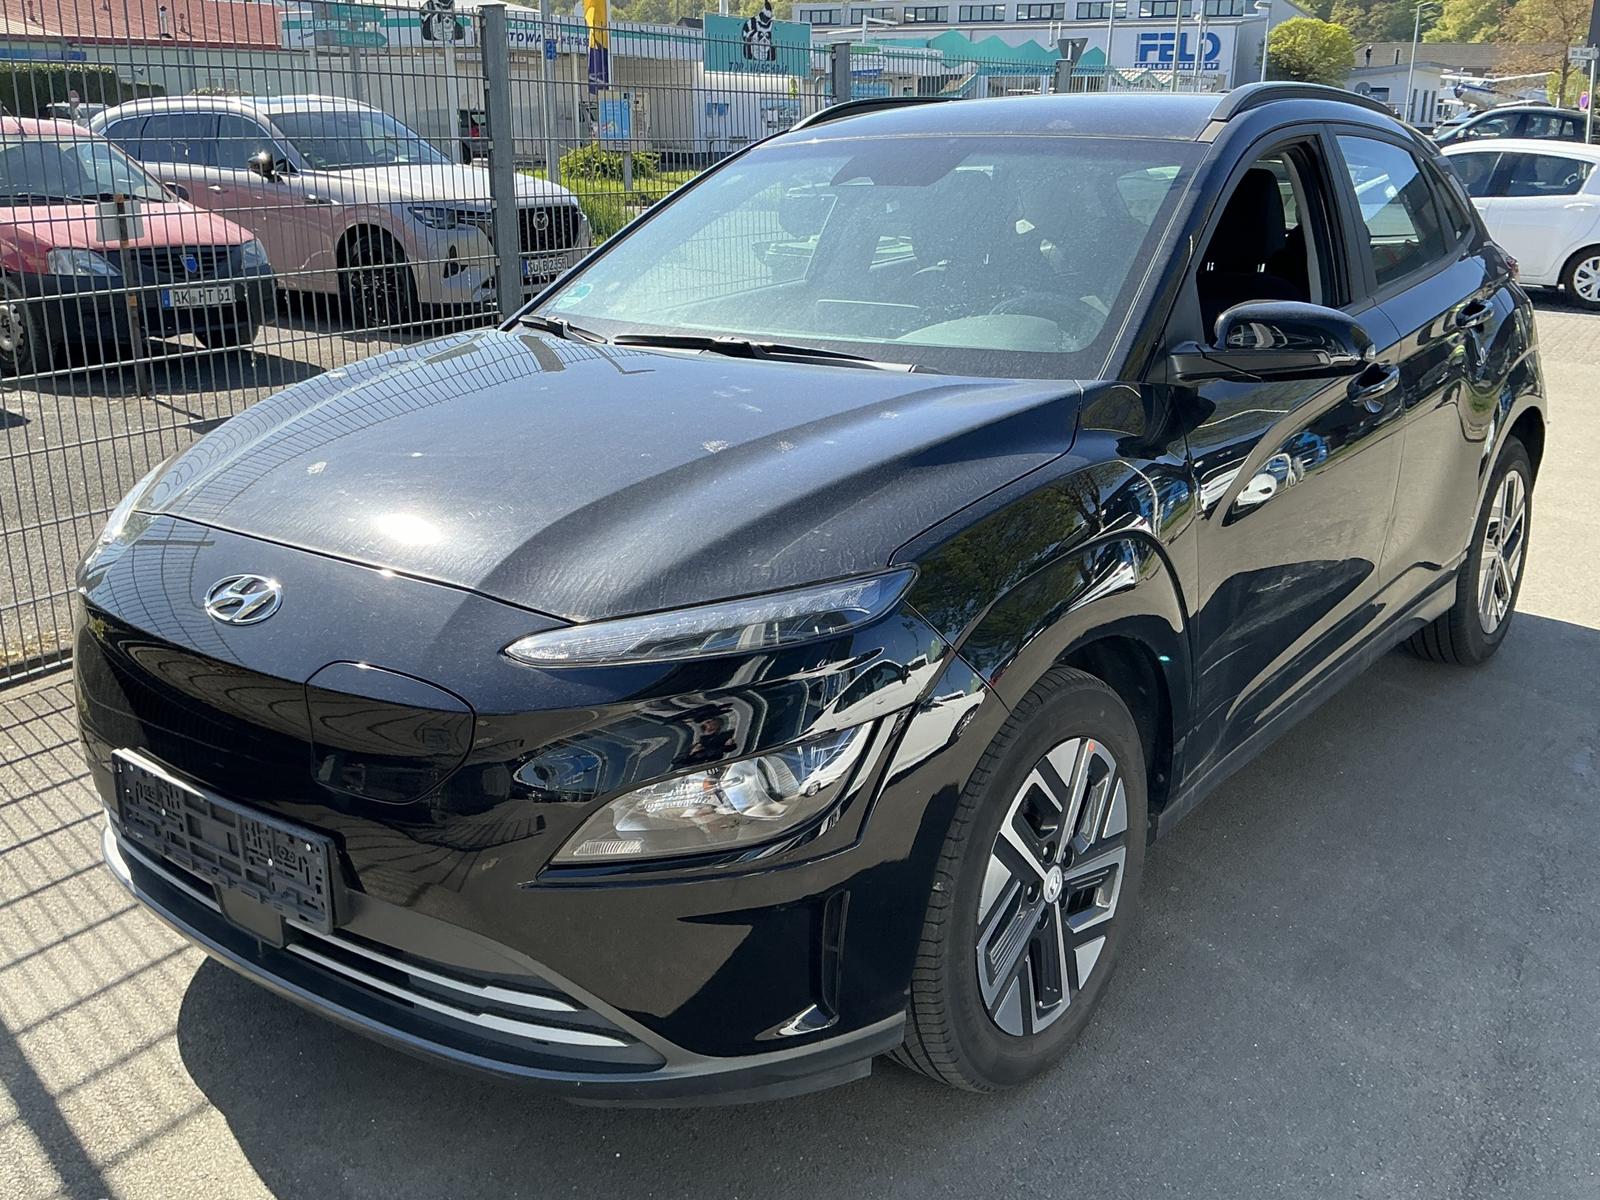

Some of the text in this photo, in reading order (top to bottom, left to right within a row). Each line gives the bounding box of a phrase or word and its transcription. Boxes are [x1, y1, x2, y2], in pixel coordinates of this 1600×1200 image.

[1139, 32, 1221, 62] FELD
[542, 260, 548, 271] B
[174, 290, 190, 305] AK
